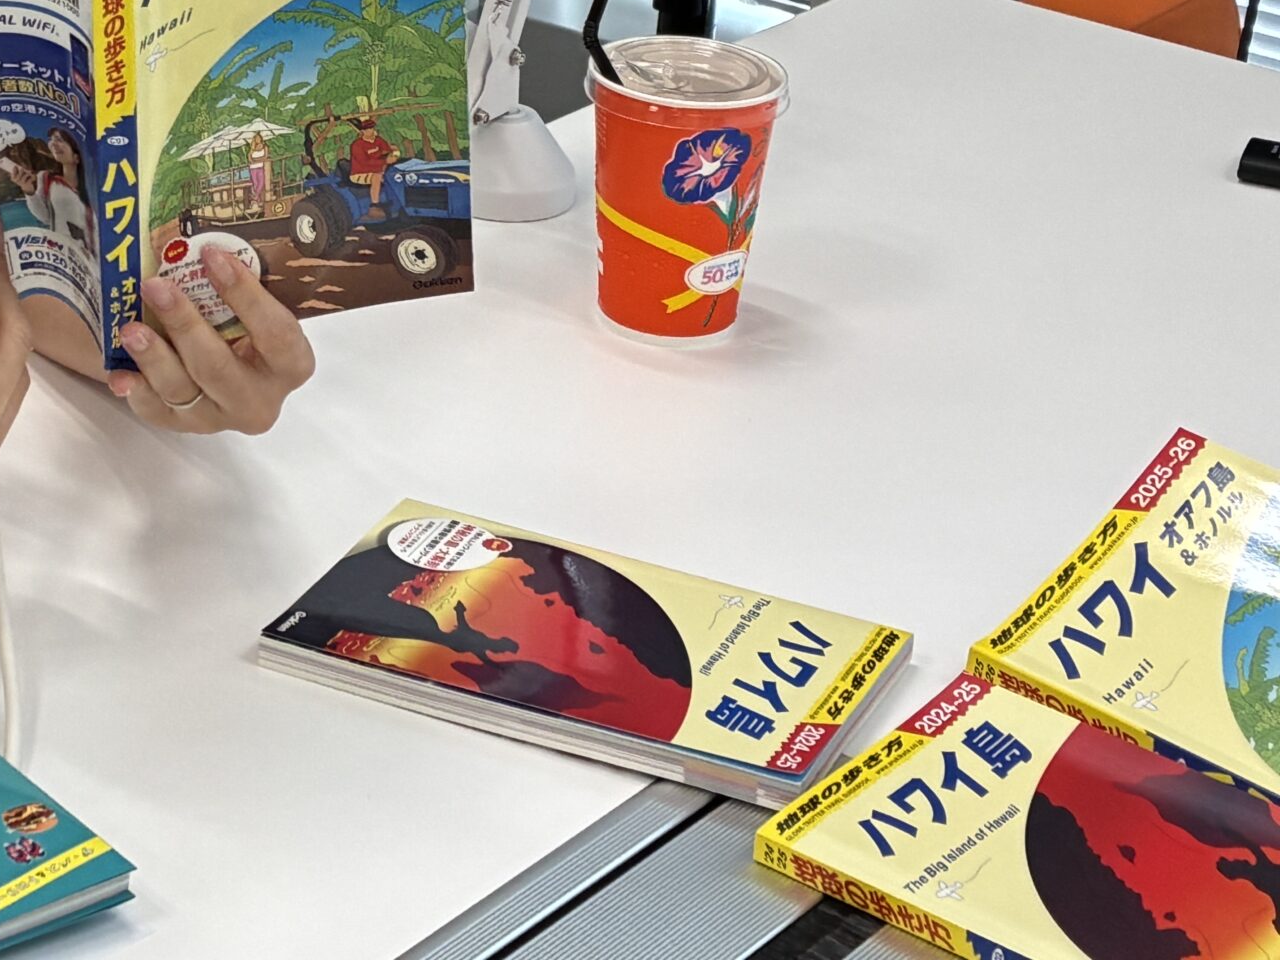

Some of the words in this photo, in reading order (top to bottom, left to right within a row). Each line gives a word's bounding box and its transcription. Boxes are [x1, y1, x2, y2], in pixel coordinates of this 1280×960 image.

[21, 16, 56, 36] WiFi
[139, 7, 194, 53] Hawaii
[102, 158, 137, 272] ハワイ
[122, 276, 137, 323] オアフ
[412, 277, 463, 290] Gakken
[1130, 436, 1196, 508] 2025~26
[1158, 461, 1236, 548] オアフ島
[1089, 516, 1139, 570] www.arukikata.co.jp
[1180, 548, 1199, 566] &
[751, 597, 771, 611] The
[989, 514, 1119, 649] 地球の歩き方
[723, 621, 751, 644] Island
[738, 608, 761, 622] Big
[1048, 541, 1177, 680] ハワイ
[696, 651, 725, 676] Hawaii
[715, 642, 734, 654] of
[705, 620, 833, 741] ハワイ島
[826, 630, 900, 721] 地球の歩き方
[1102, 657, 1154, 705] Hawaii
[916, 680, 981, 734] 2024~25
[776, 724, 826, 769] 2024~25
[775, 735, 904, 836] 地球の歩き方
[858, 721, 1032, 858] ハワイ島
[903, 872, 929, 894] The
[924, 857, 949, 878] Big
[944, 835, 977, 863] Island
[975, 824, 989, 842] of
[986, 804, 1020, 834] Hawaii
[790, 852, 955, 951] 地球の歩き方
